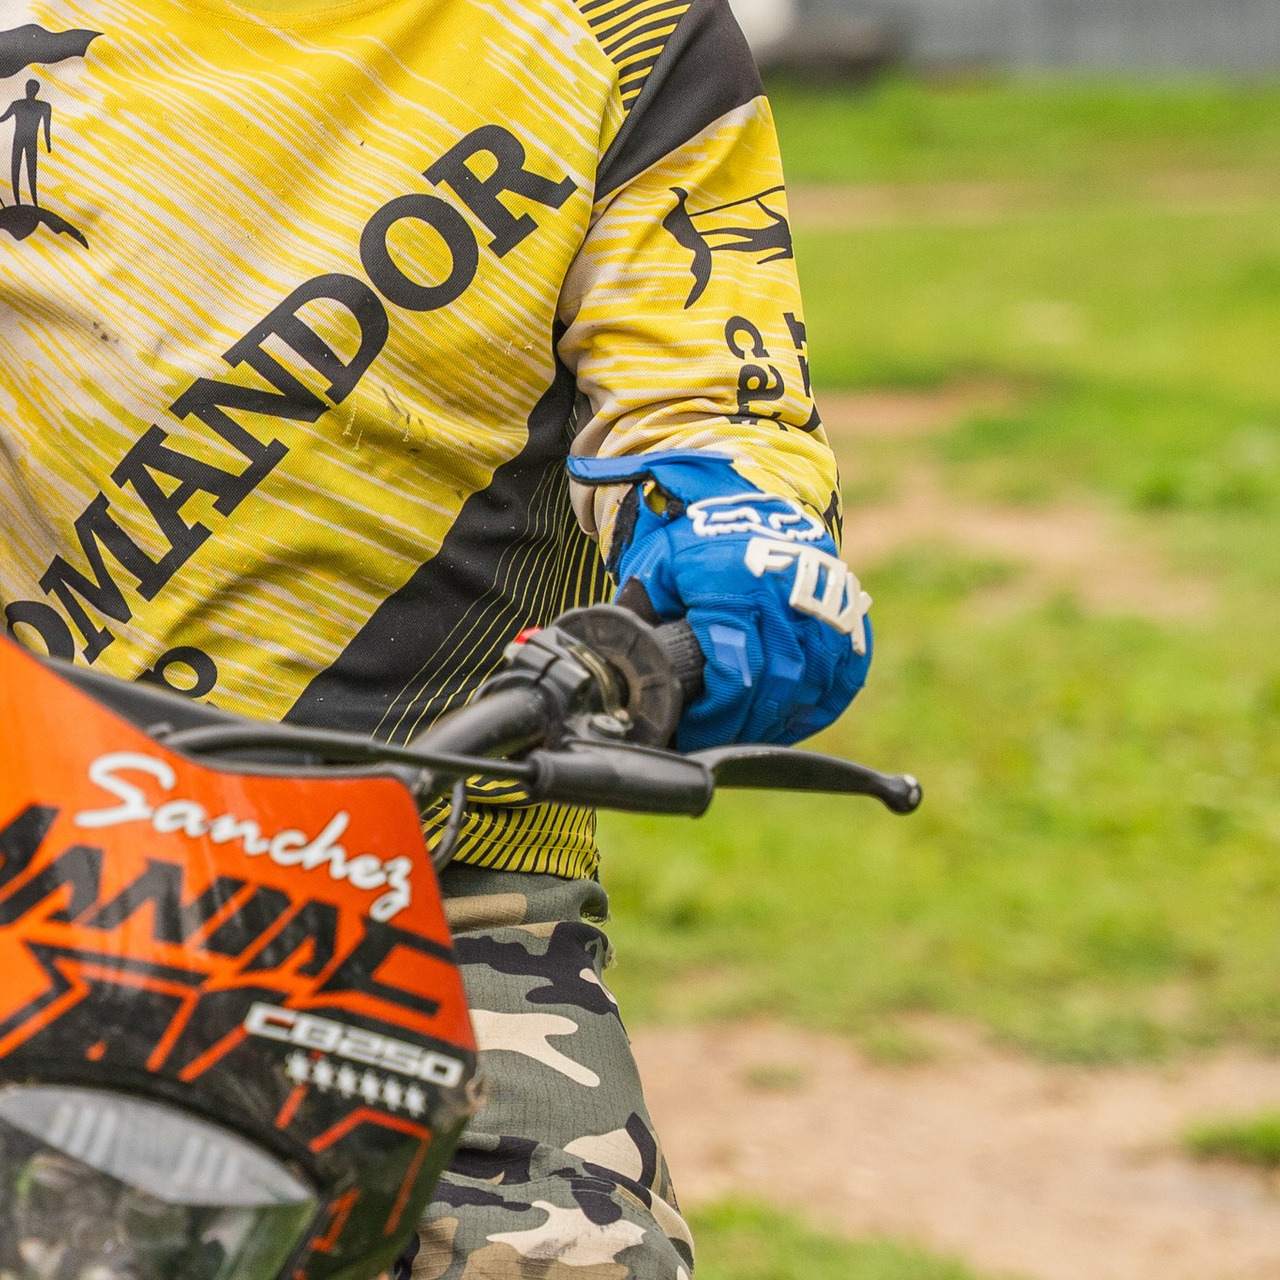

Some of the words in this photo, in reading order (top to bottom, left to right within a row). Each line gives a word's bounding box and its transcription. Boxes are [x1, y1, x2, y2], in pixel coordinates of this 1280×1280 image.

[5, 124, 577, 665] OMANDOR
[744, 536, 873, 657] FOX
[74, 751, 413, 922] Sanchez
[243, 1001, 465, 1089] CB250
